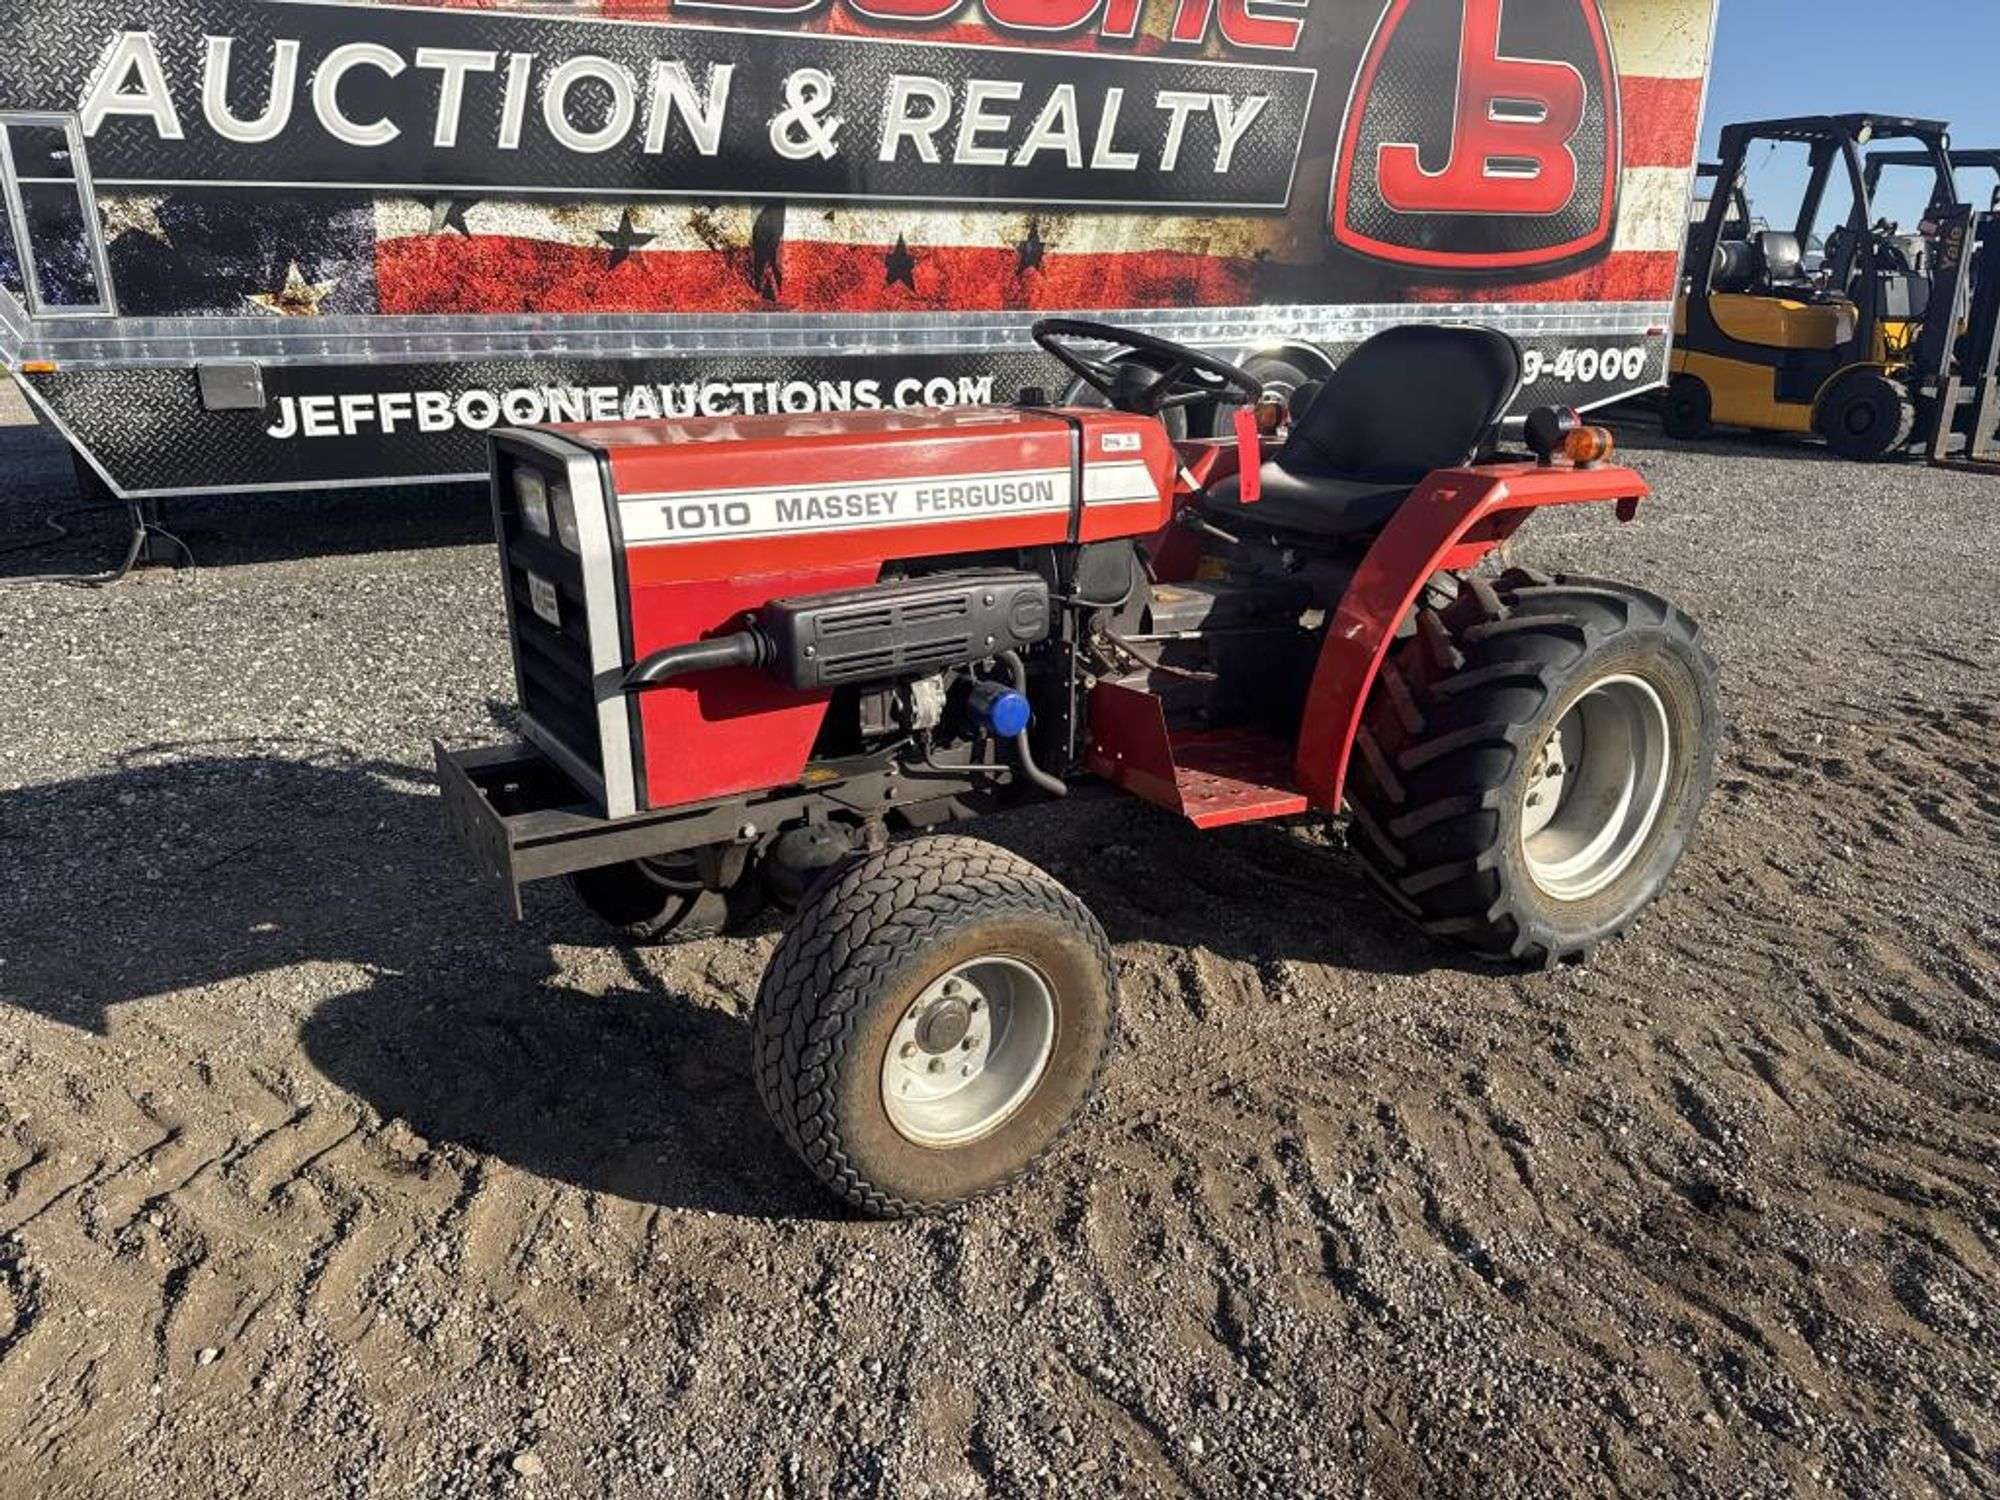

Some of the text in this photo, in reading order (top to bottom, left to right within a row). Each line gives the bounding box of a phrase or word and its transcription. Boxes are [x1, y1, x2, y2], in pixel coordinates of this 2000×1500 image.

[80, 30, 1271, 173] AUCTION & REALTY
[266, 376, 993, 439] JEFFBOONEAUCTIONS.COM
[660, 479, 1055, 530] 1010 MASSEY FERGUSON
